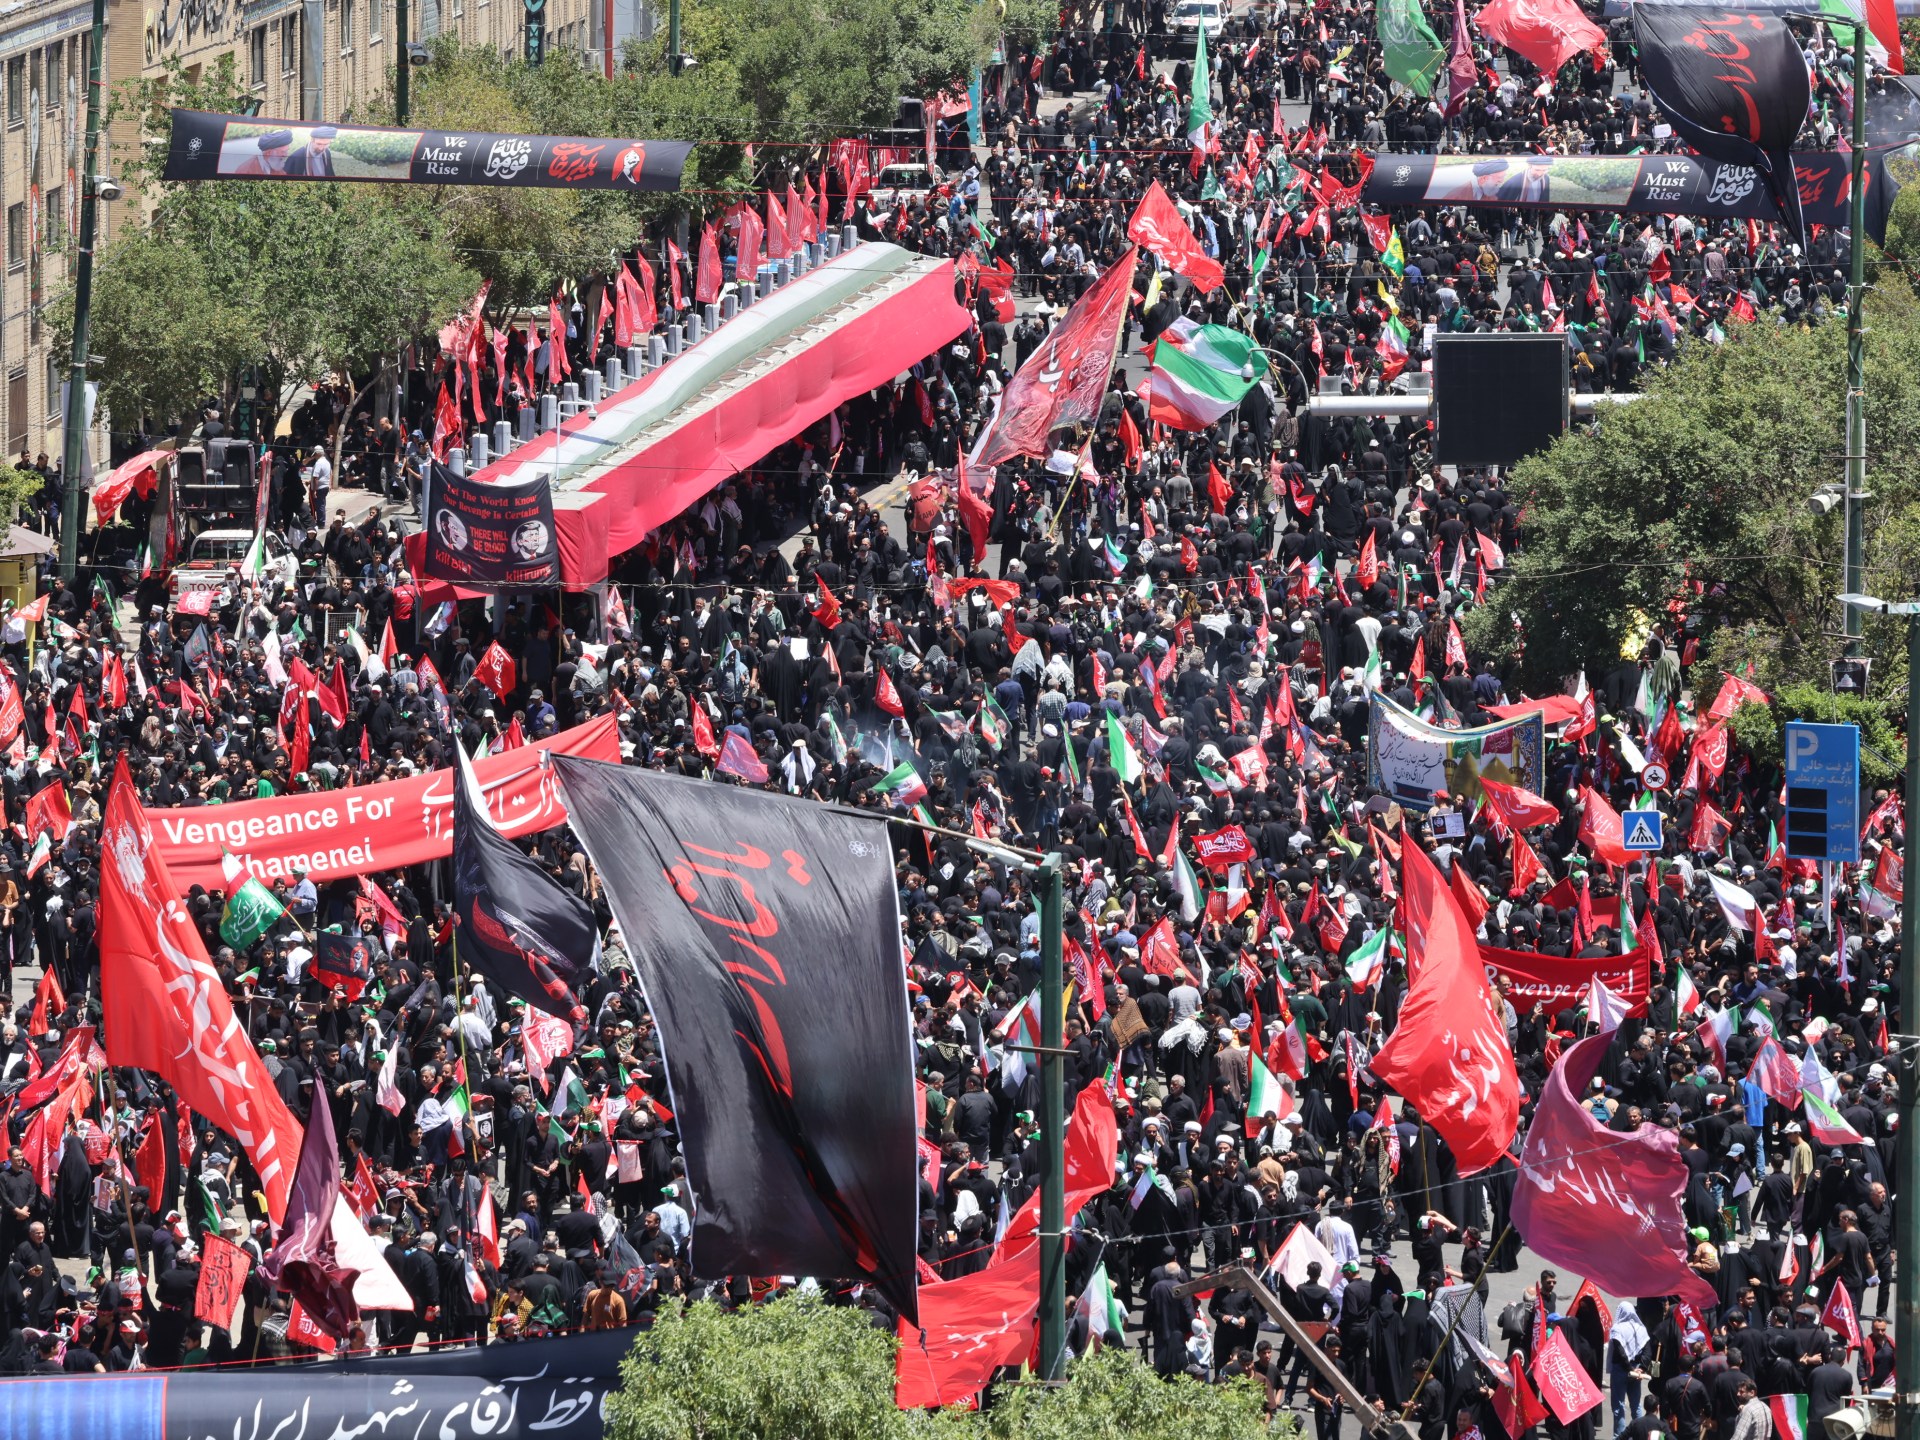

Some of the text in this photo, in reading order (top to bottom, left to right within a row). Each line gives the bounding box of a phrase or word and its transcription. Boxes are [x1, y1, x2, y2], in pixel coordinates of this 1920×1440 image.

[444, 136, 467, 148] We
[422, 148, 462, 162] Must
[426, 162, 459, 175] Rise
[1664, 162, 1690, 173] We
[1643, 174, 1687, 187] Must
[1646, 187, 1681, 201] Rise
[447, 483, 538, 507] Let The World Know
[443, 494, 456, 507] Our
[459, 502, 490, 520] Revenge
[493, 511, 502, 520] Is
[470, 526, 508, 542] THERE WILL
[473, 540, 507, 554] BE BLOOD
[1788, 730, 1819, 771] P
[162, 808, 339, 848] Vengeance
[346, 796, 395, 825] For
